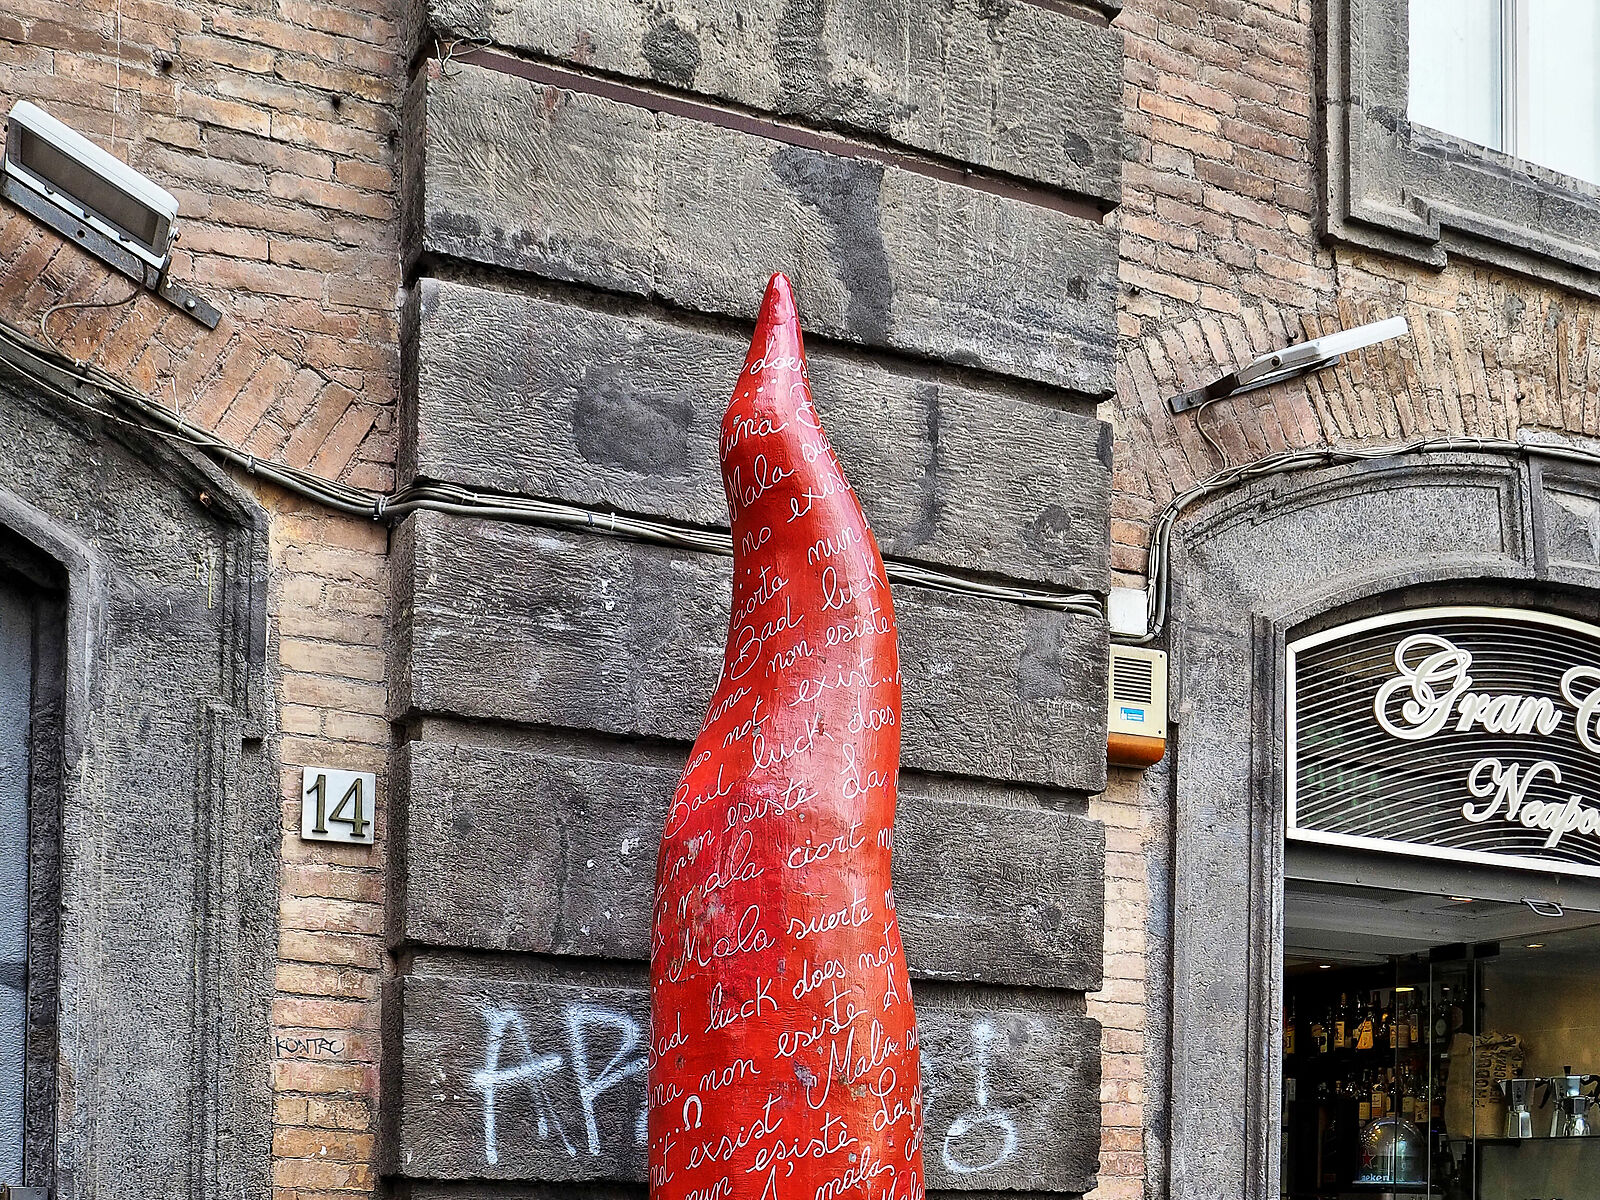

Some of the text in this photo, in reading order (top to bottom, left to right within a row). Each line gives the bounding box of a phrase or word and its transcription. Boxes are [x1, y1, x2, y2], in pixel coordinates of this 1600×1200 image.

[726, 454, 794, 522] Mala
[742, 527, 771, 556] no
[808, 526, 862, 566] nun
[730, 596, 803, 680] Bad
[765, 639, 814, 678] non
[723, 695, 770, 748] not
[1374, 633, 1563, 740] Gran
[306, 773, 371, 838] 14
[663, 690, 895, 840] Bad luck does
[670, 829, 716, 881] nn
[723, 780, 819, 834] esiste
[668, 904, 775, 982] Mala
[786, 889, 874, 940] suerte
[705, 976, 778, 1034] luck
[792, 959, 847, 1000] does
[858, 920, 898, 971] not
[699, 1058, 761, 1092] non
[774, 980, 868, 1060] esiste
[806, 1018, 899, 1110] Mala
